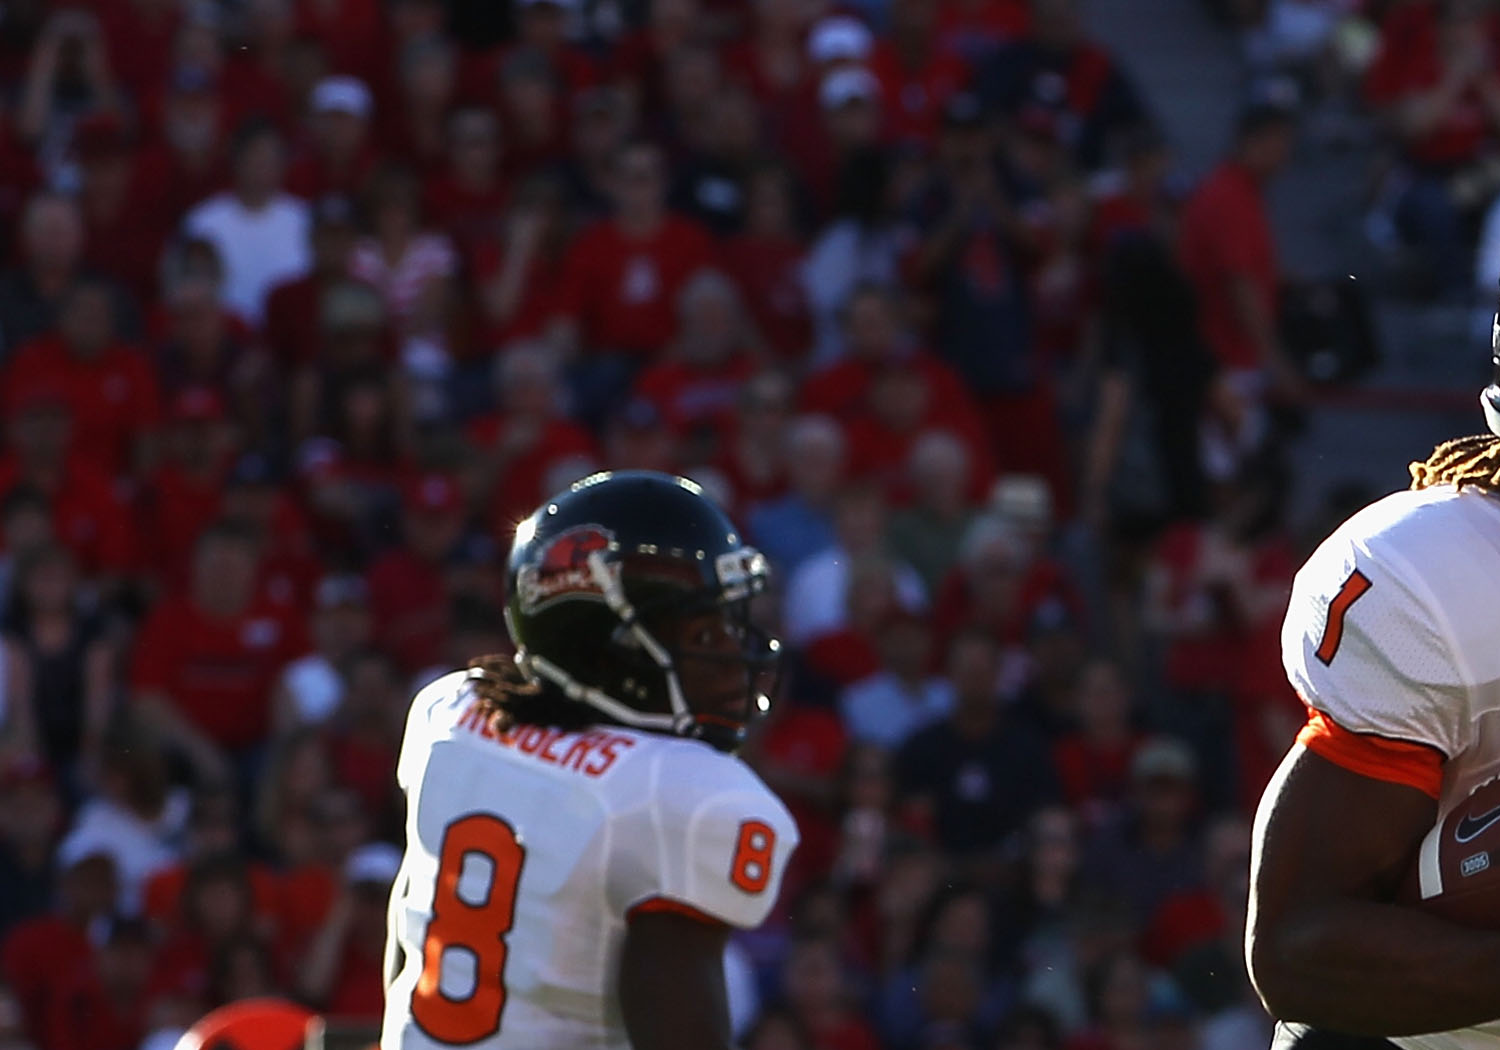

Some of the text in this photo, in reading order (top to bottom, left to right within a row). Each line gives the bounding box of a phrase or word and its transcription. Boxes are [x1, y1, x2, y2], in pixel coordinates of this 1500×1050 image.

[1315, 568, 1373, 667] 1
[729, 820, 775, 894] 8
[411, 813, 526, 1045] 8
